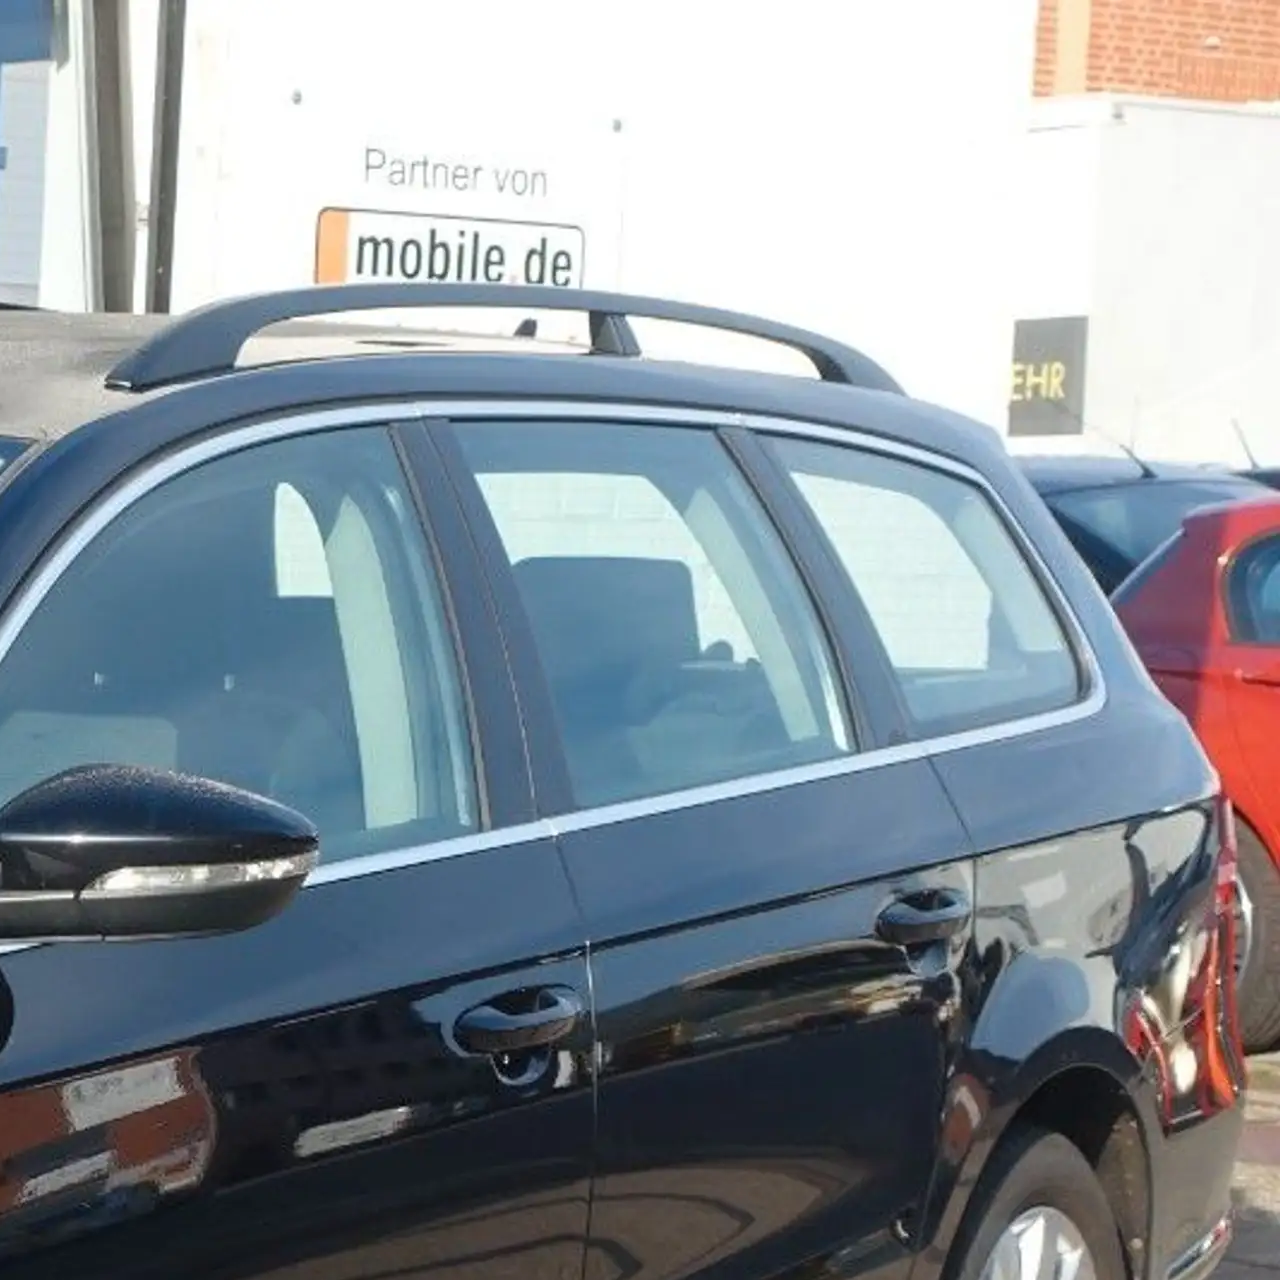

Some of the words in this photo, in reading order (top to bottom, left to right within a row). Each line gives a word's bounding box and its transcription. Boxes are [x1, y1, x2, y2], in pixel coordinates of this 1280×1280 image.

[364, 147, 482, 192] Partner
[494, 168, 547, 197] von
[356, 228, 572, 287] mobile.de
